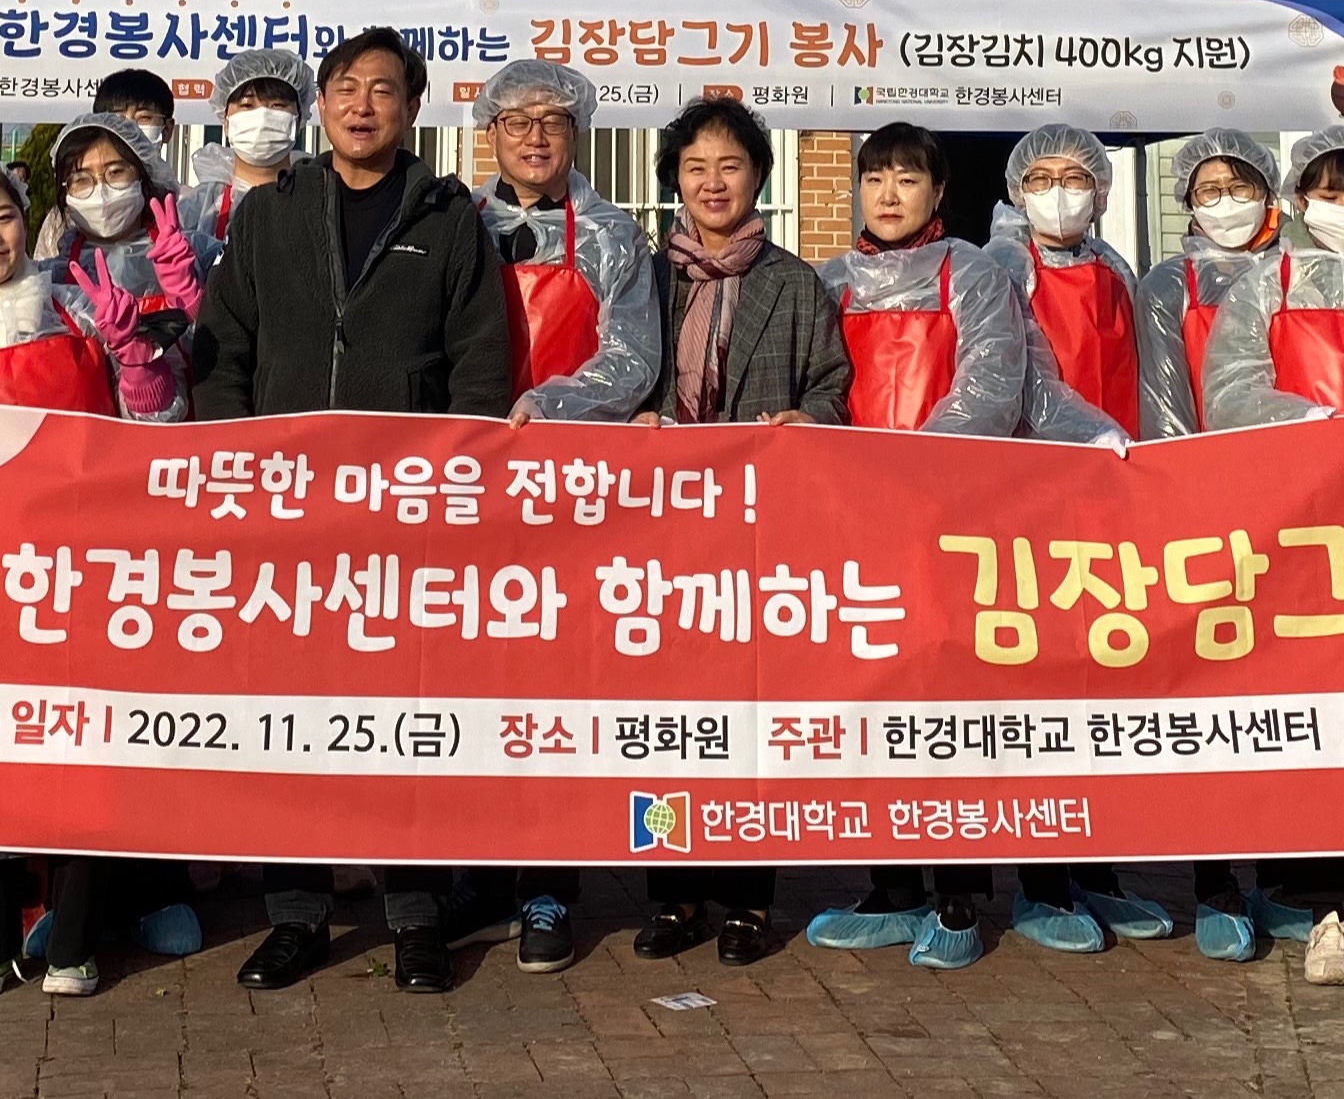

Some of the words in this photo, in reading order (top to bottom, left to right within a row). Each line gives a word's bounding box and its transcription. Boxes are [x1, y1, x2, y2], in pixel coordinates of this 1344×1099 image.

[363, 25, 510, 62] 께하는
[530, 18, 771, 68] 김장담그기
[789, 21, 884, 69] 봉사
[899, 32, 1045, 69] (김장김치
[1055, 35, 1164, 73] 400kg
[1172, 35, 1252, 71] 지원)
[752, 85, 810, 106] 평화원
[955, 86, 1062, 107] 한경봉사센터
[147, 450, 314, 520] 따뜻한
[334, 455, 485, 525] 마음을
[1, 542, 568, 653] 한경봉사센터와
[594, 556, 907, 660] 함께하는
[11, 699, 90, 746] 일자
[127, 709, 240, 752] 2022.
[327, 713, 462, 759] 25.(금)
[500, 713, 576, 759] 장소
[614, 714, 731, 761] 평화원
[768, 715, 846, 761] 주관
[882, 713, 1077, 761] 한경대학교
[1088, 706, 1322, 757] 한경봉사센터
[700, 792, 873, 843] 한경대학교
[887, 797, 1092, 841] 한경봉사센터
